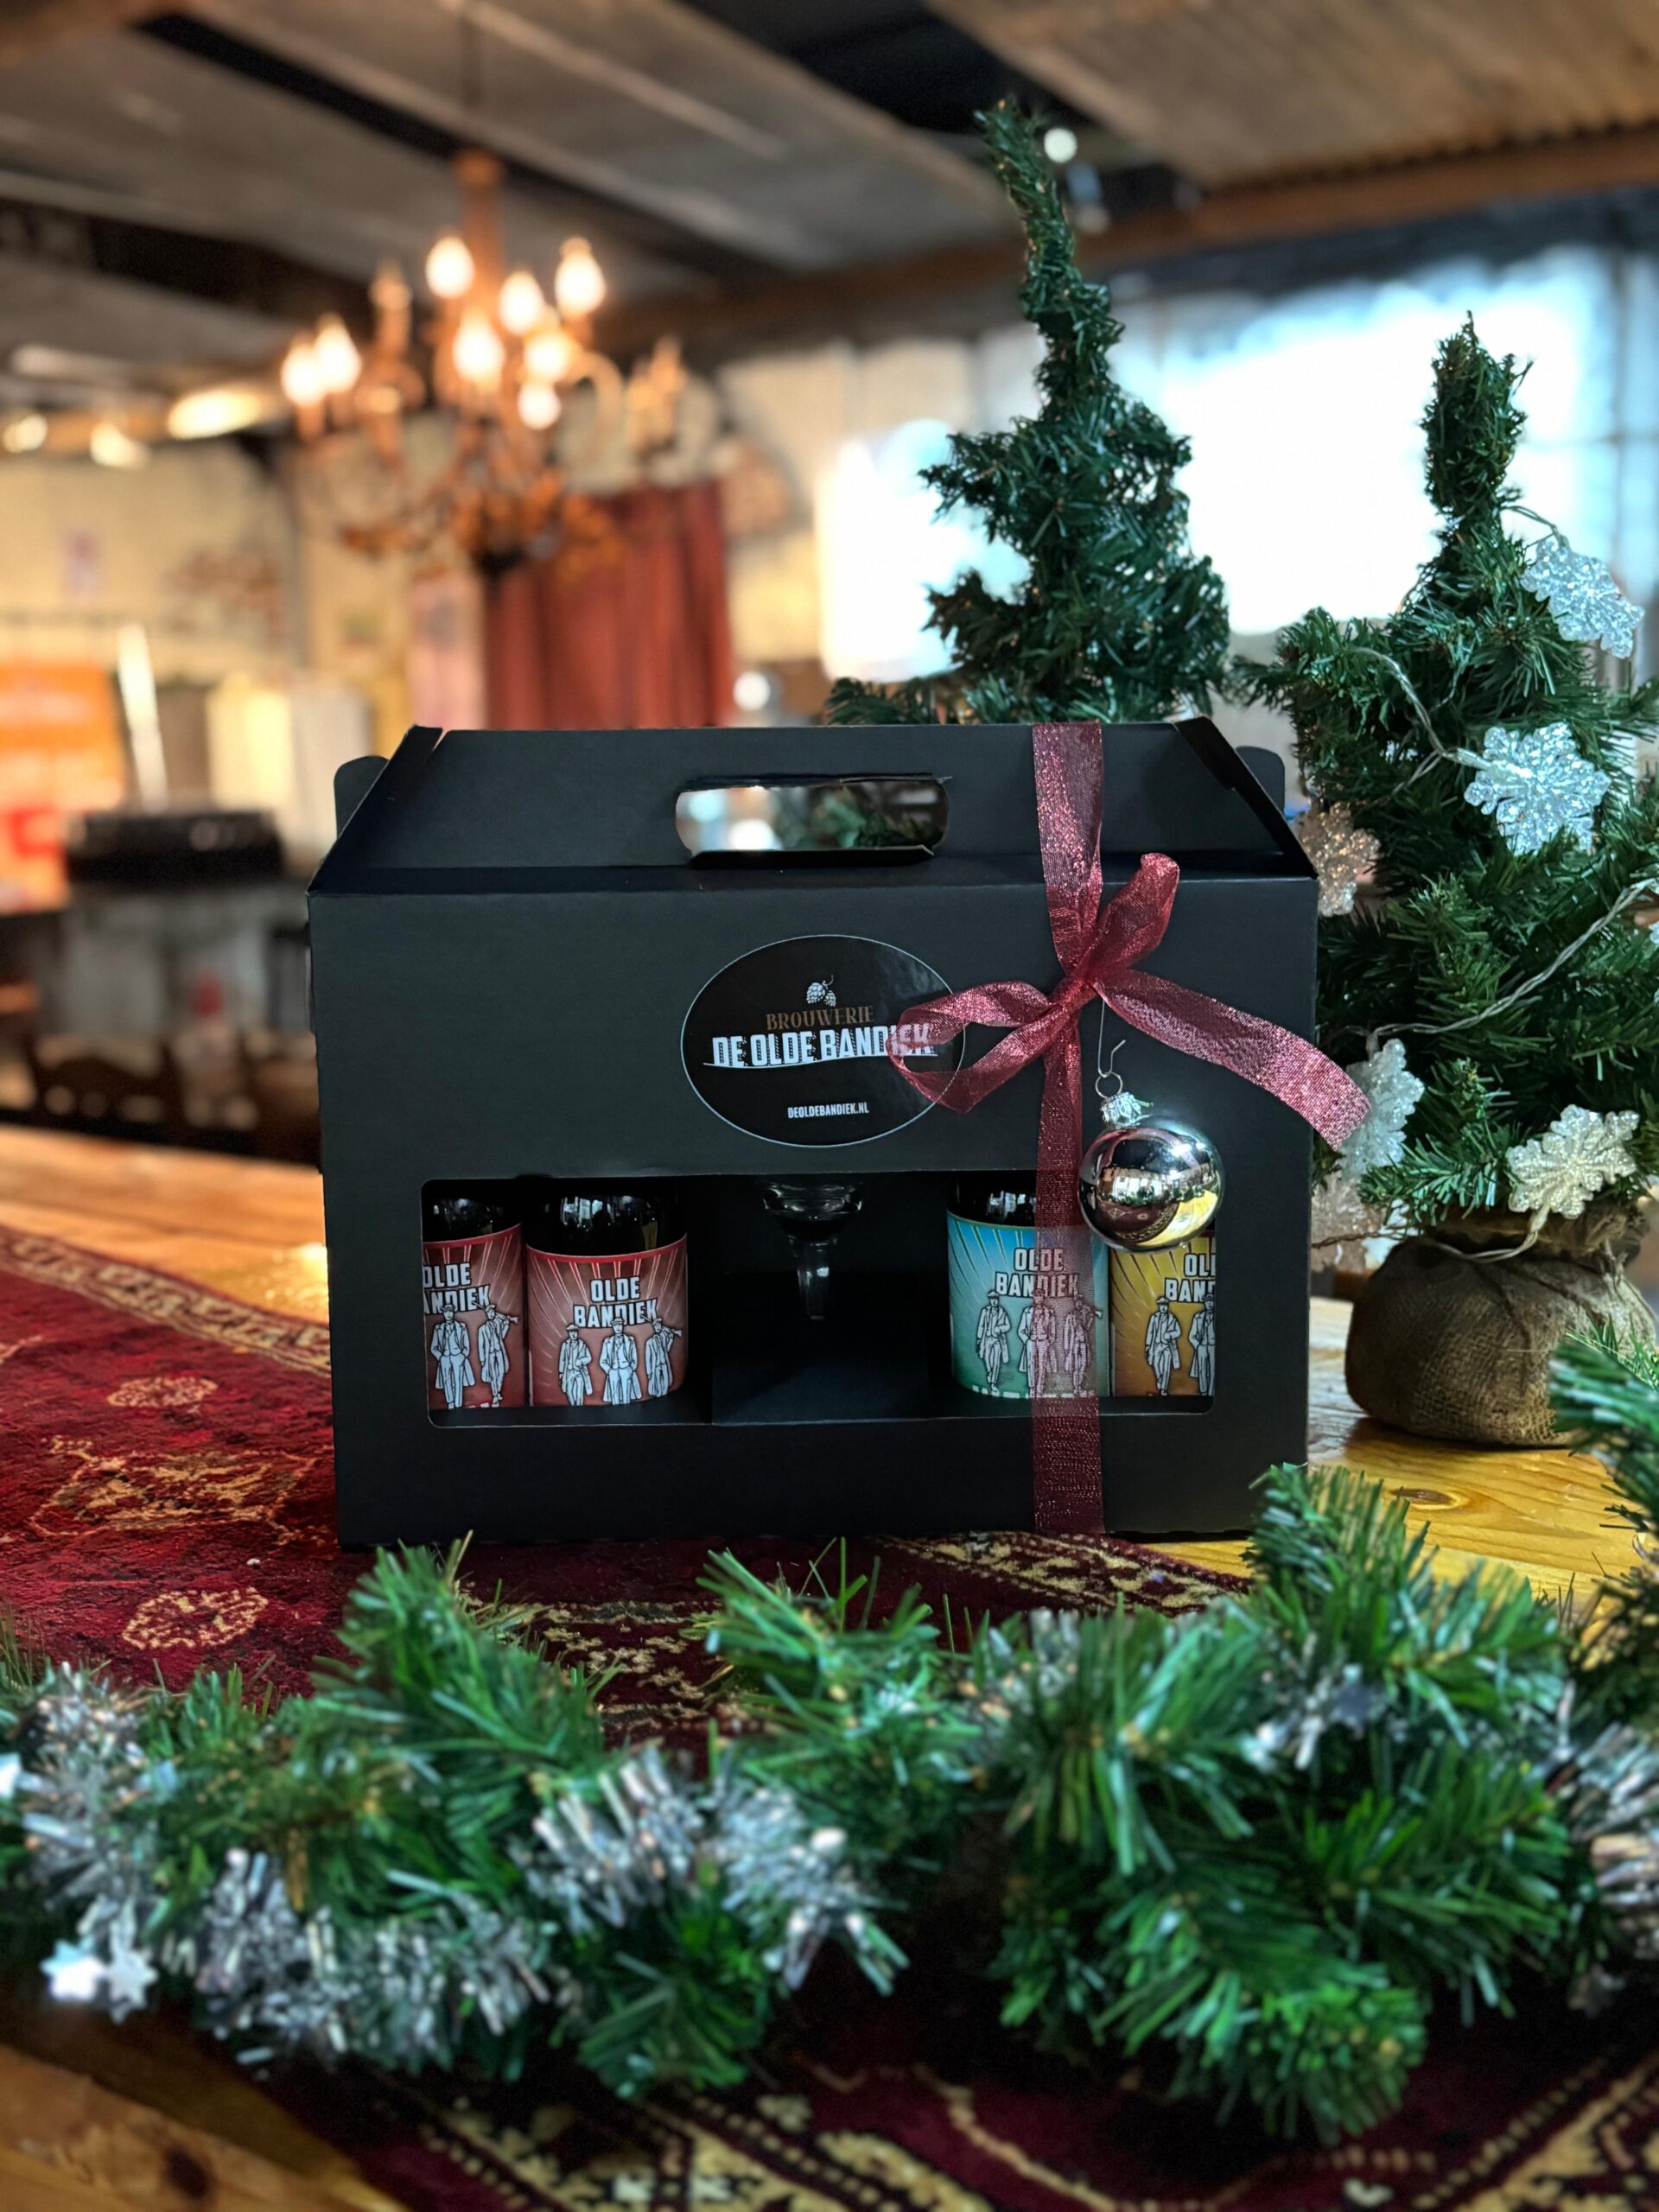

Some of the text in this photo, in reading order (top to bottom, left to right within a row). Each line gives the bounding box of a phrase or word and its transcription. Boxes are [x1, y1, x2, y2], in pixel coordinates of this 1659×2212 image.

[766, 1005, 875, 1031] BROUWERIE
[712, 1035, 747, 1067] DE
[750, 1030, 817, 1066] OLDE
[787, 1102, 869, 1119] DEOLDEBANDIEK.NL
[1014, 1248, 1065, 1272] OLDE
[590, 1276, 641, 1303] OLDE
[995, 1272, 1079, 1298] BANDIEK
[574, 1299, 658, 1328] BANDIEK
